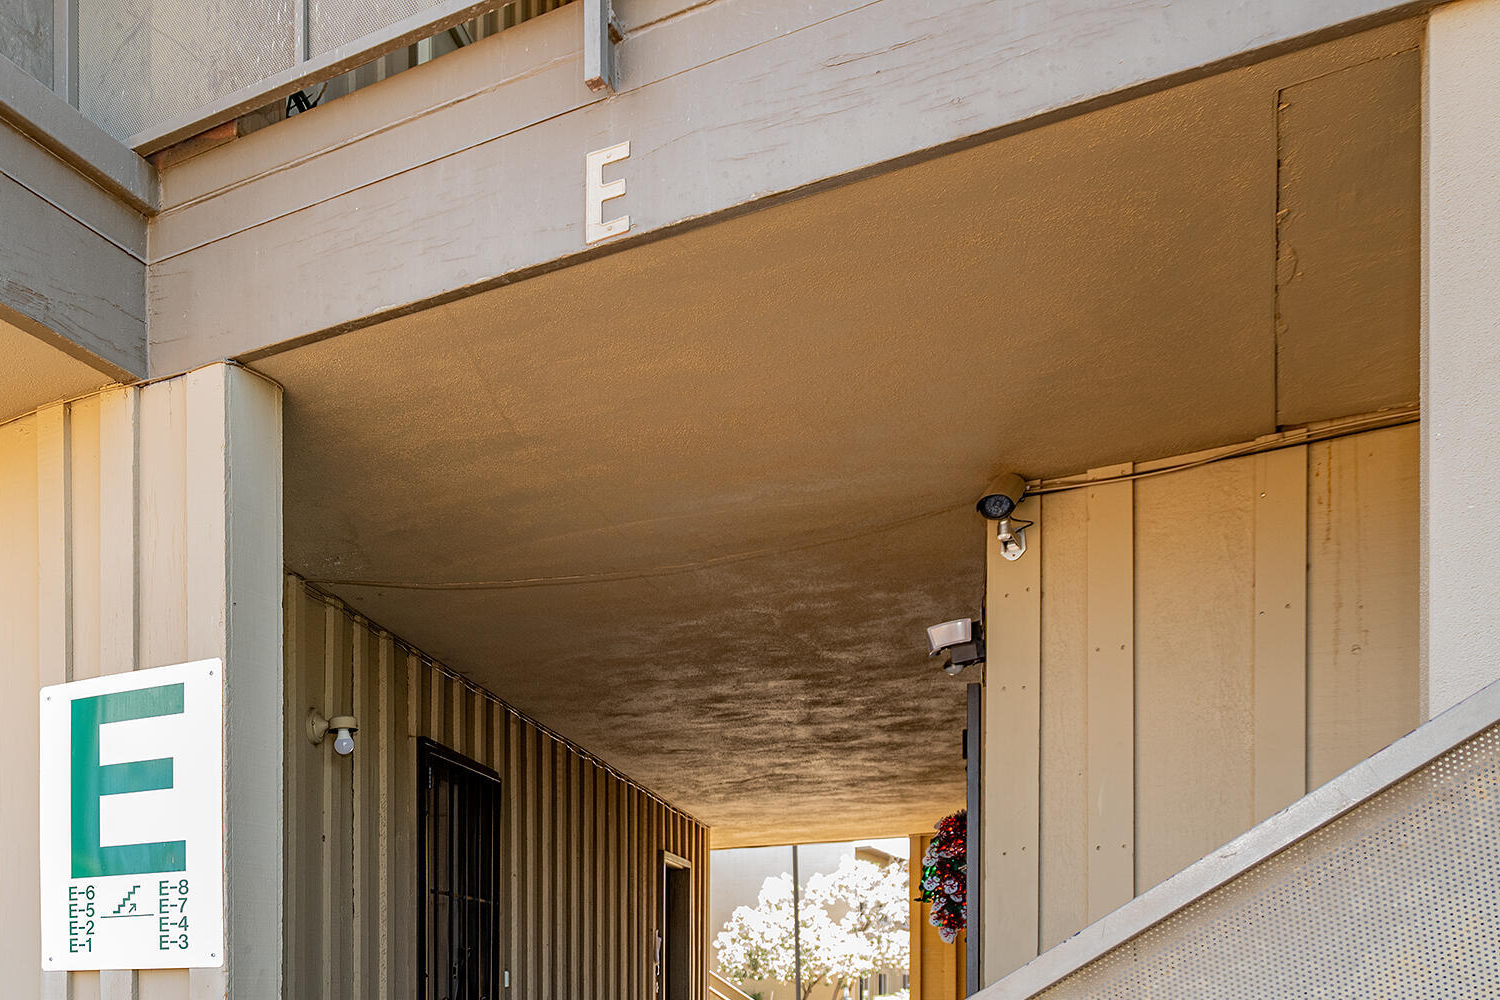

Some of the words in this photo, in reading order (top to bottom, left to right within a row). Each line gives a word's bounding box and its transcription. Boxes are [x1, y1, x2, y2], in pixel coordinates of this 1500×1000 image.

[585, 140, 631, 245] E
[71, 682, 186, 879] E
[68, 885, 96, 901] E-6
[159, 879, 190, 896] E-8
[68, 902, 96, 918] E-5
[159, 897, 188, 914] E-7
[69, 920, 96, 936] E-2
[159, 915, 190, 932] E-4
[69, 937, 92, 953] E-1
[159, 933, 190, 950] E-3
